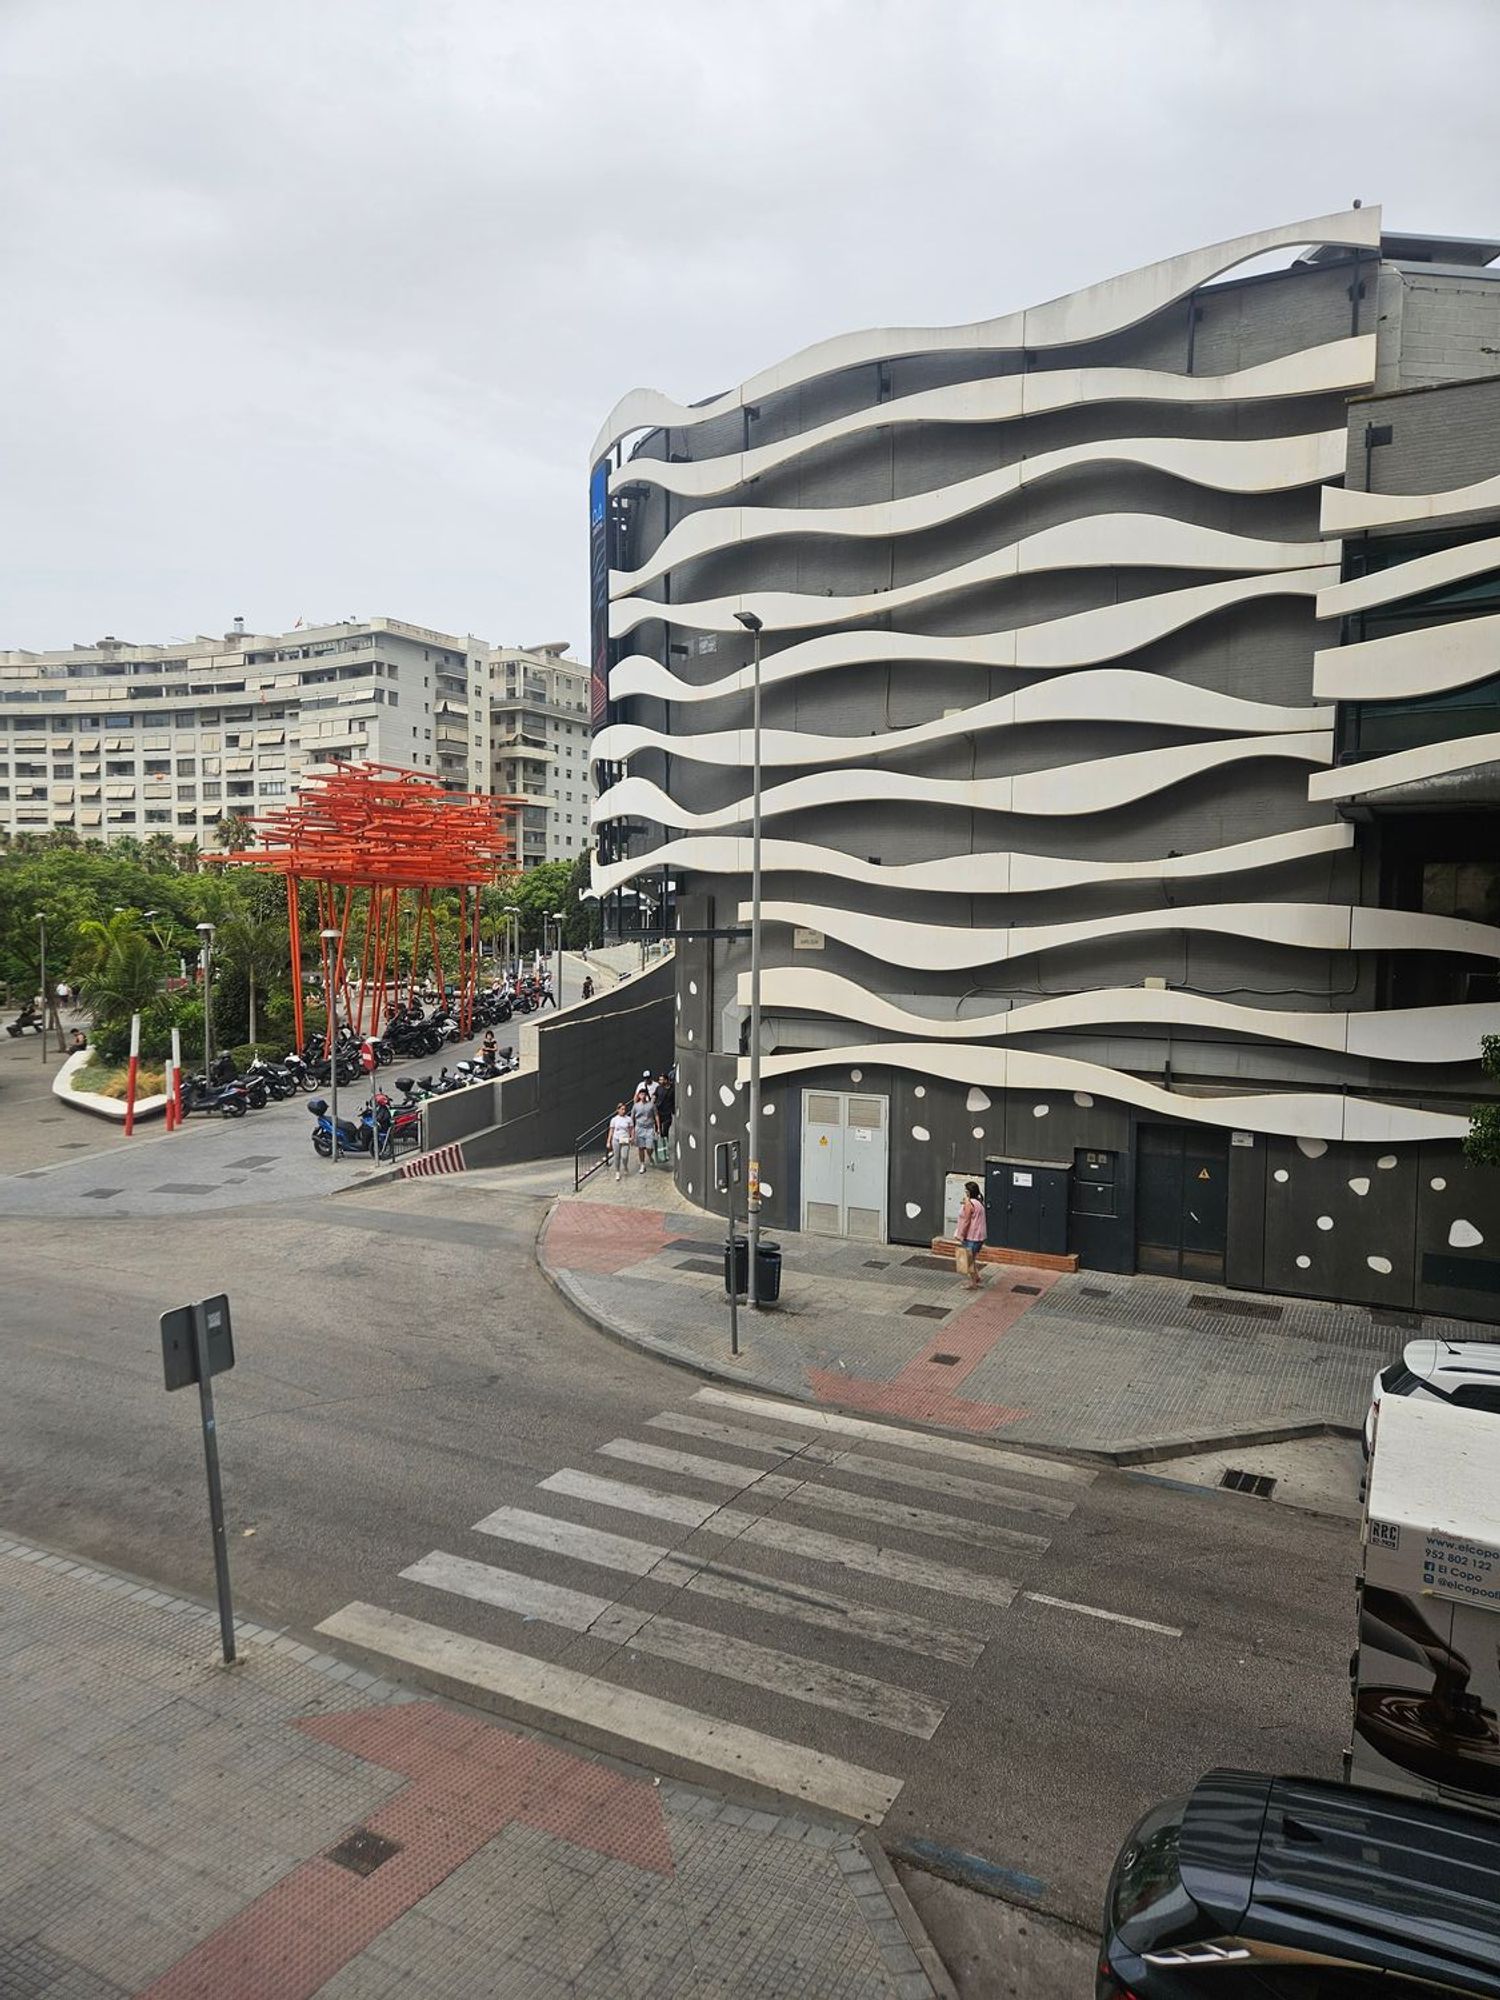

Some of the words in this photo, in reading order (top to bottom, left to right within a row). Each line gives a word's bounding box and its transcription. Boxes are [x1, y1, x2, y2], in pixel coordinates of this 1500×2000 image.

[1425, 1548, 1444, 1560] 952
[1448, 1553, 1468, 1566] 802
[1473, 1559, 1492, 1571] 122
[1439, 1564, 1447, 1574] El
[1451, 1567, 1482, 1582] Copo
